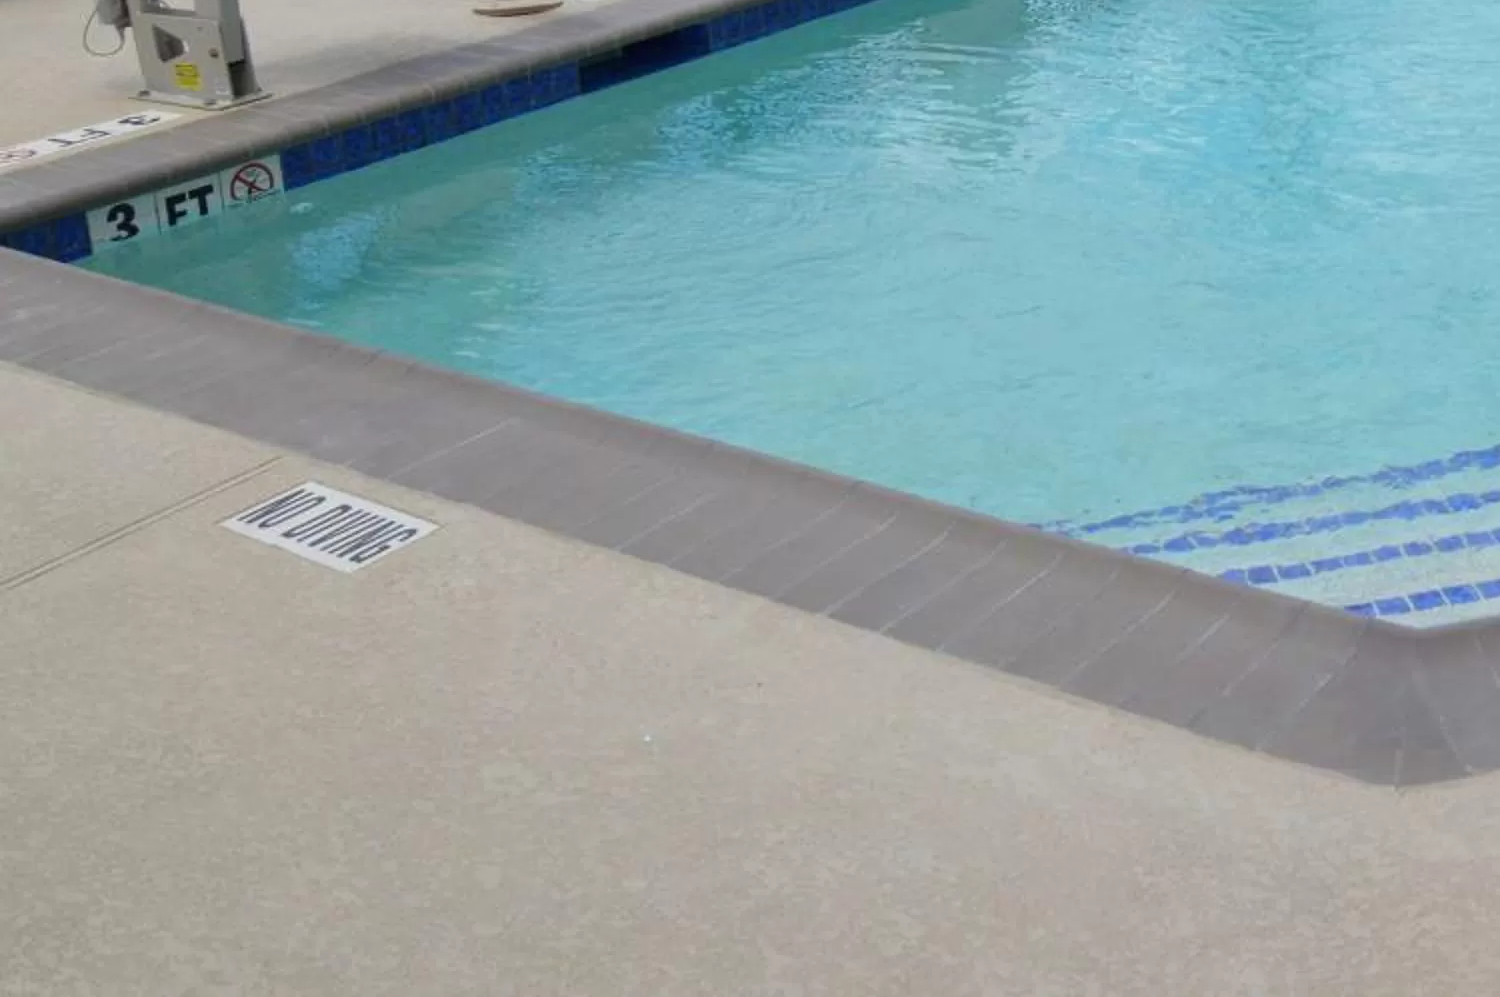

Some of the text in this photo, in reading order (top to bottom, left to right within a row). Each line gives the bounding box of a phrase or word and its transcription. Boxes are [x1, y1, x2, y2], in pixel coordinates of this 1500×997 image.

[106, 183, 214, 242] 3 FT
[236, 488, 419, 563] NO DIVING
